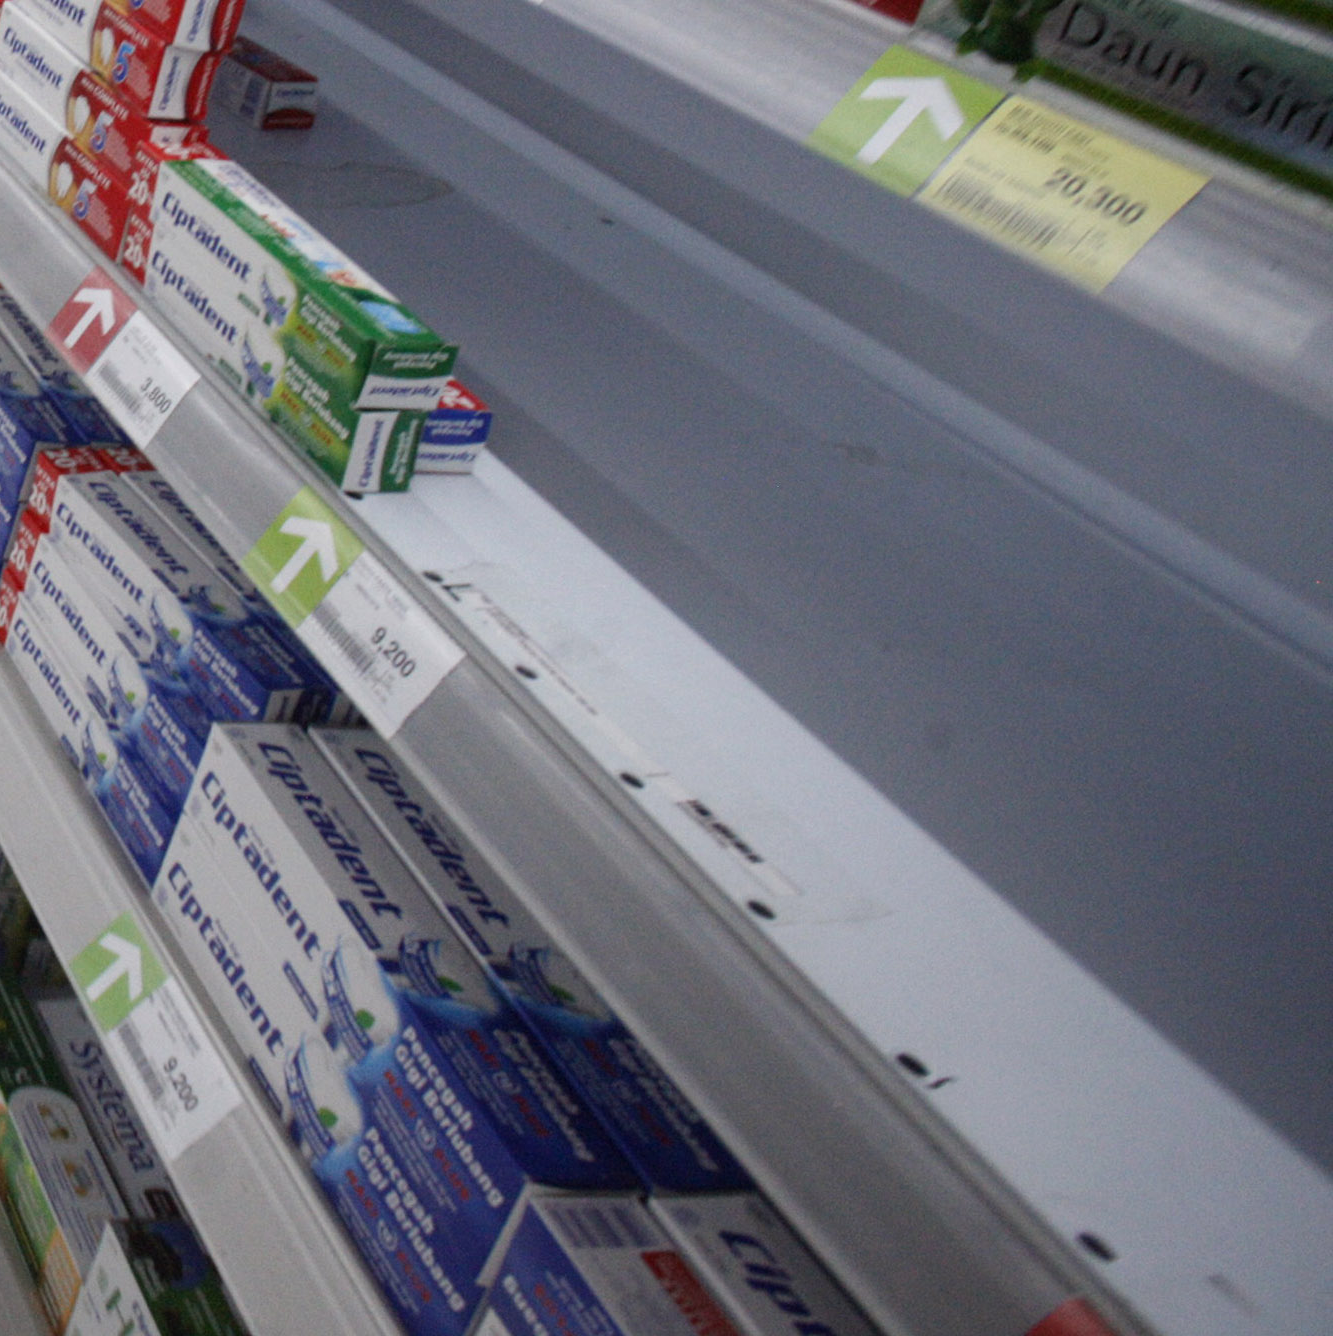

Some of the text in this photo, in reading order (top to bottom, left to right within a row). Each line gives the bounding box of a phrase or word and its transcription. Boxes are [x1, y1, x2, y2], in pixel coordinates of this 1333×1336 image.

[3, 26, 63, 90] Ciptadent
[113, 39, 136, 84] 5
[1057, 1, 1210, 96] Daun
[90, 110, 114, 152] 5
[73, 179, 96, 219] 5
[162, 191, 254, 282] Ciptadent
[151, 249, 238, 345] Ciptadent
[140, 375, 173, 417] 3,800
[55, 501, 146, 607] Ciptadent
[33, 559, 108, 668] Ciptadent
[369, 626, 417, 680] 9,200
[13, 616, 82, 727] Ciptadent
[201, 771, 322, 961] Ciptadent
[257, 741, 403, 921] Ciptadent
[354, 746, 511, 928] Ciptadent
[167, 862, 285, 1057] Ciptadent
[69, 1039, 155, 1174] Systema
[163, 1055, 200, 1114] 9,200
[395, 1044, 504, 1208] Gigi Berlubang
[402, 1025, 474, 1131] Pencegah
[358, 1145, 466, 1311] Gigi Berlubang
[365, 1126, 435, 1235] Pencegah
